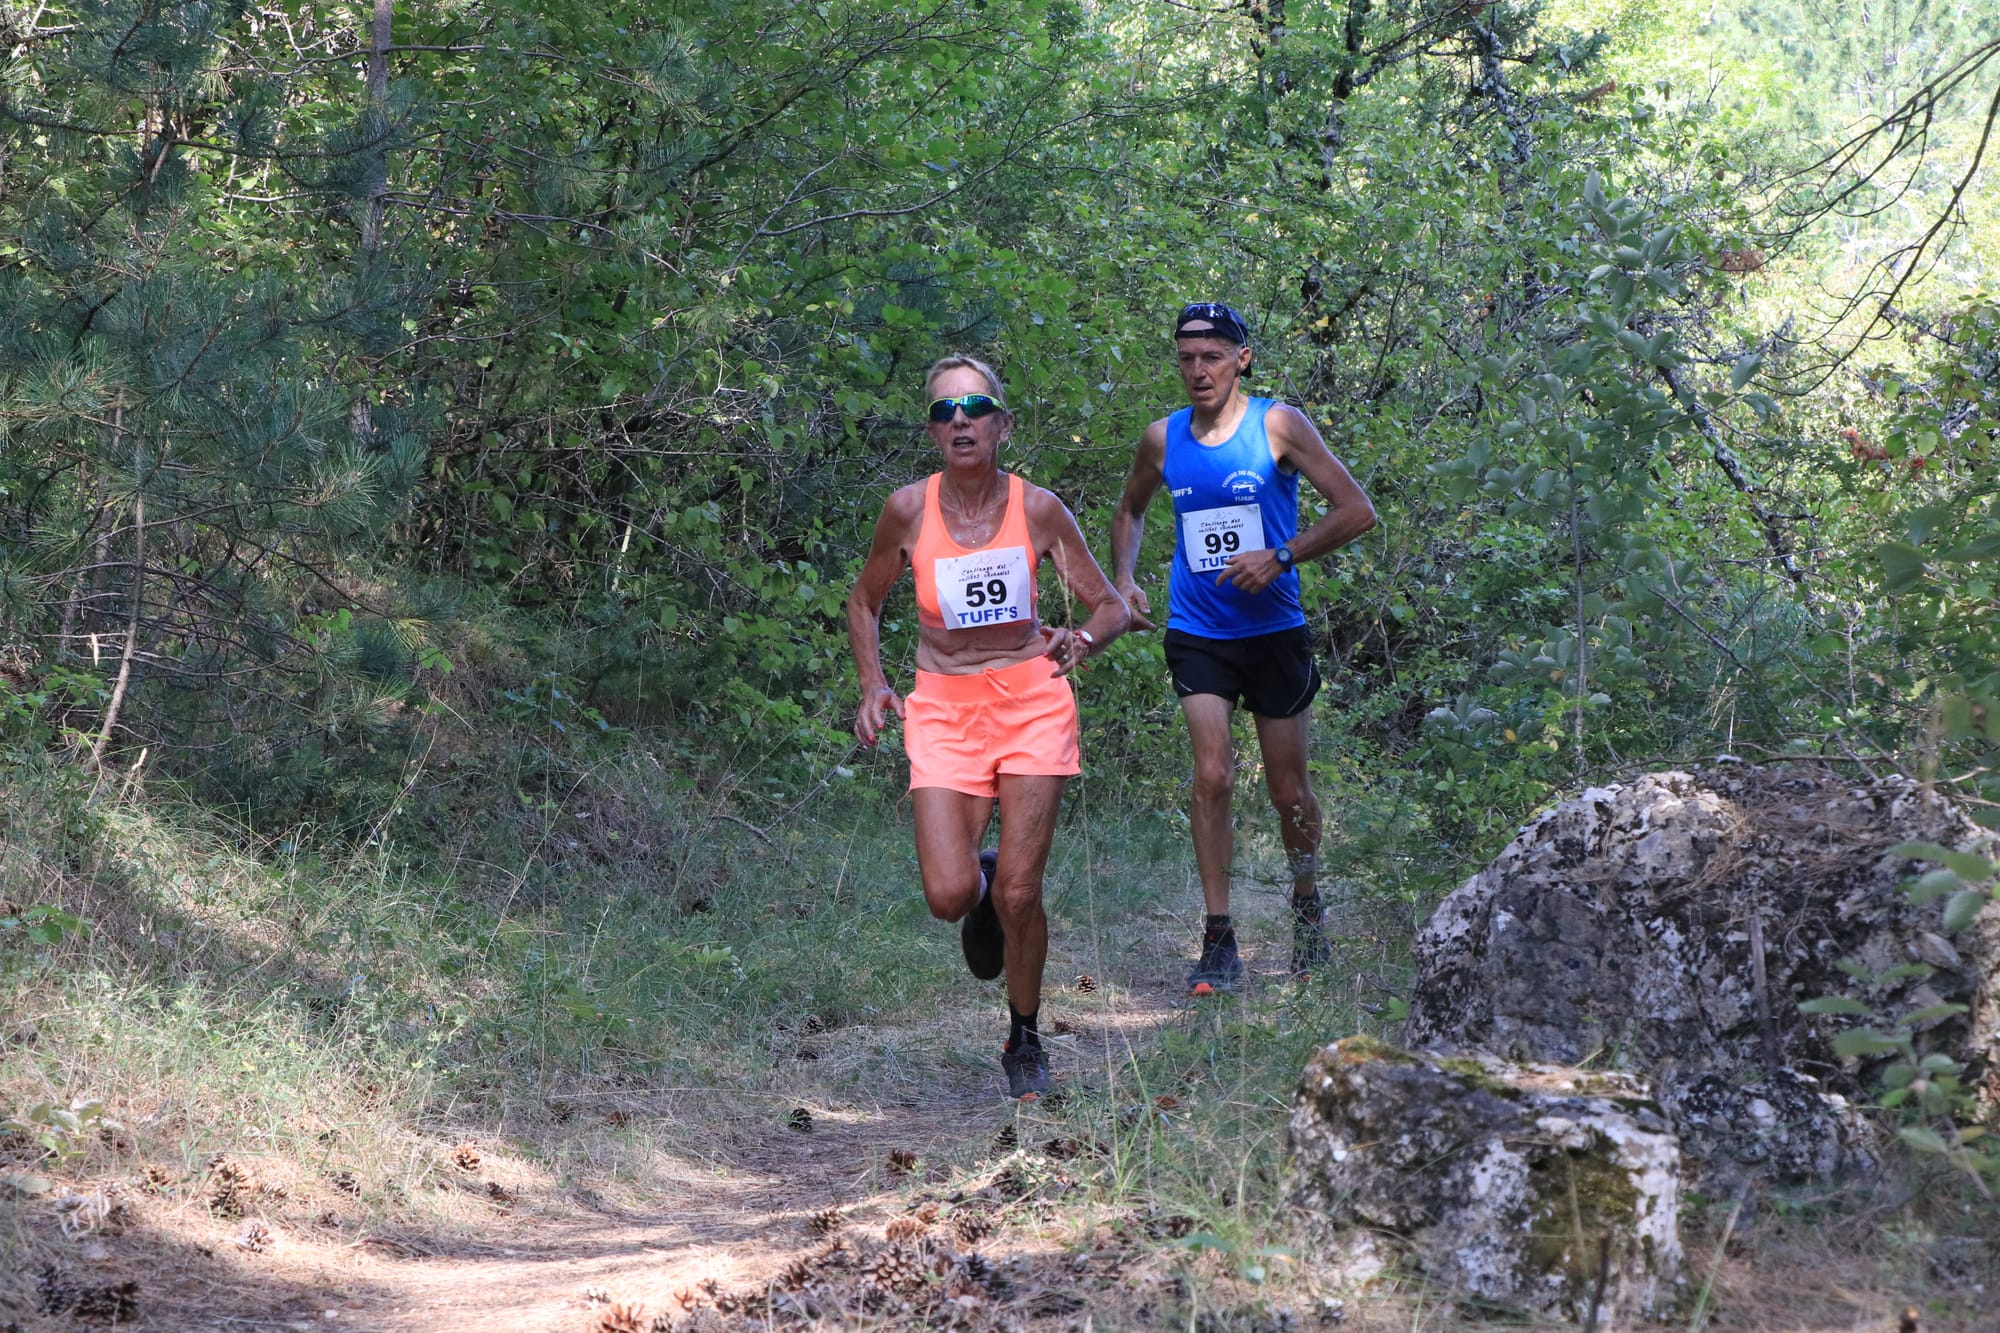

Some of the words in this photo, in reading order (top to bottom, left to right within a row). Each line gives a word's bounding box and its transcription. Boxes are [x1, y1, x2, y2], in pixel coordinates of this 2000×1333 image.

[1204, 531, 1240, 555] 99
[965, 579, 1007, 607] 59
[957, 606, 1018, 625] TUFF'S
